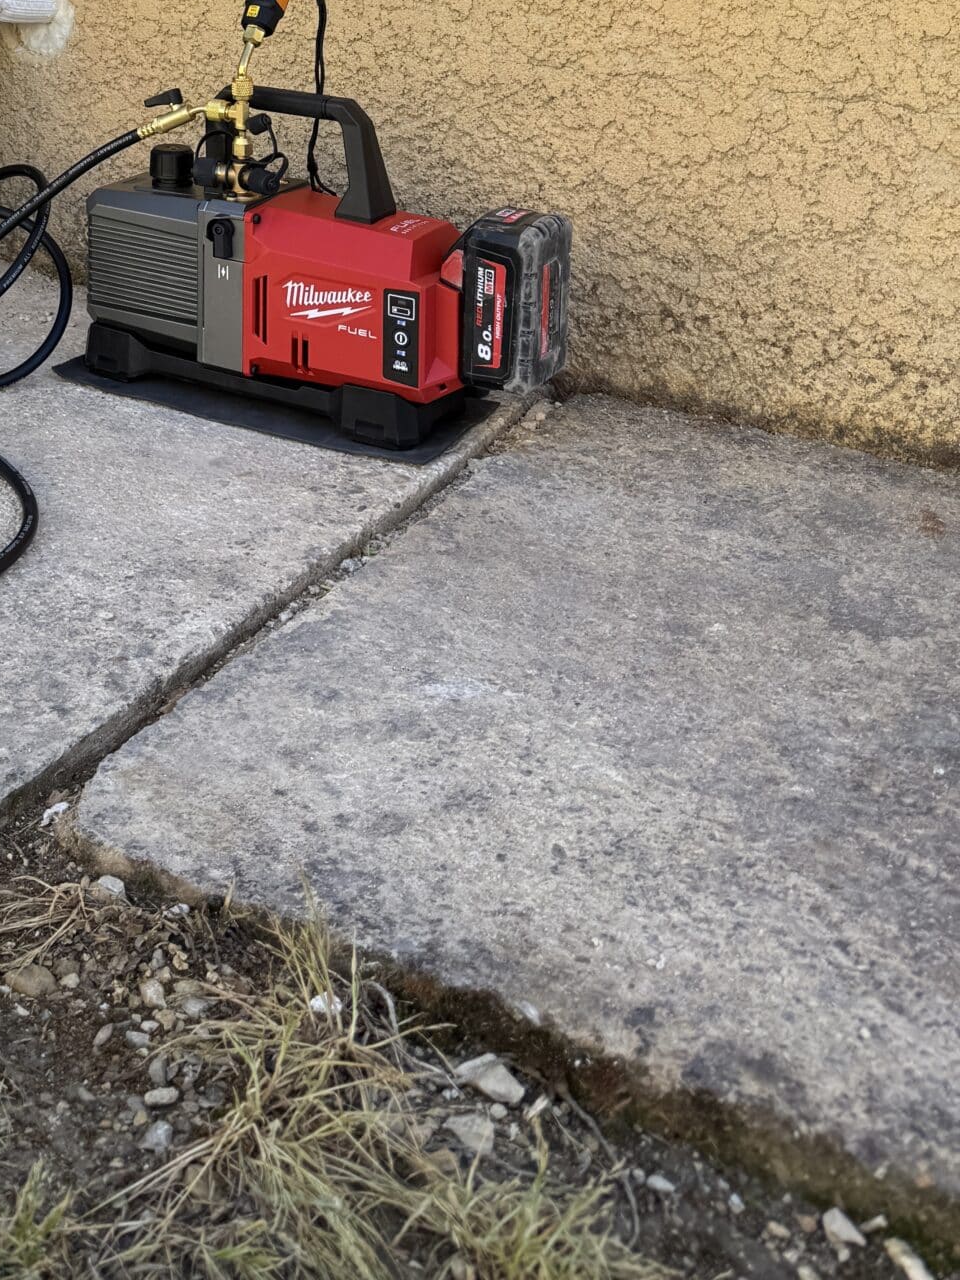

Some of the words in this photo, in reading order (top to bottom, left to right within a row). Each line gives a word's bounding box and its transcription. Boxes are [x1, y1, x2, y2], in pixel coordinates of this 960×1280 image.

[486, 271, 494, 293] M18
[282, 280, 373, 308] Milwaukee
[338, 324, 377, 339] FUEL
